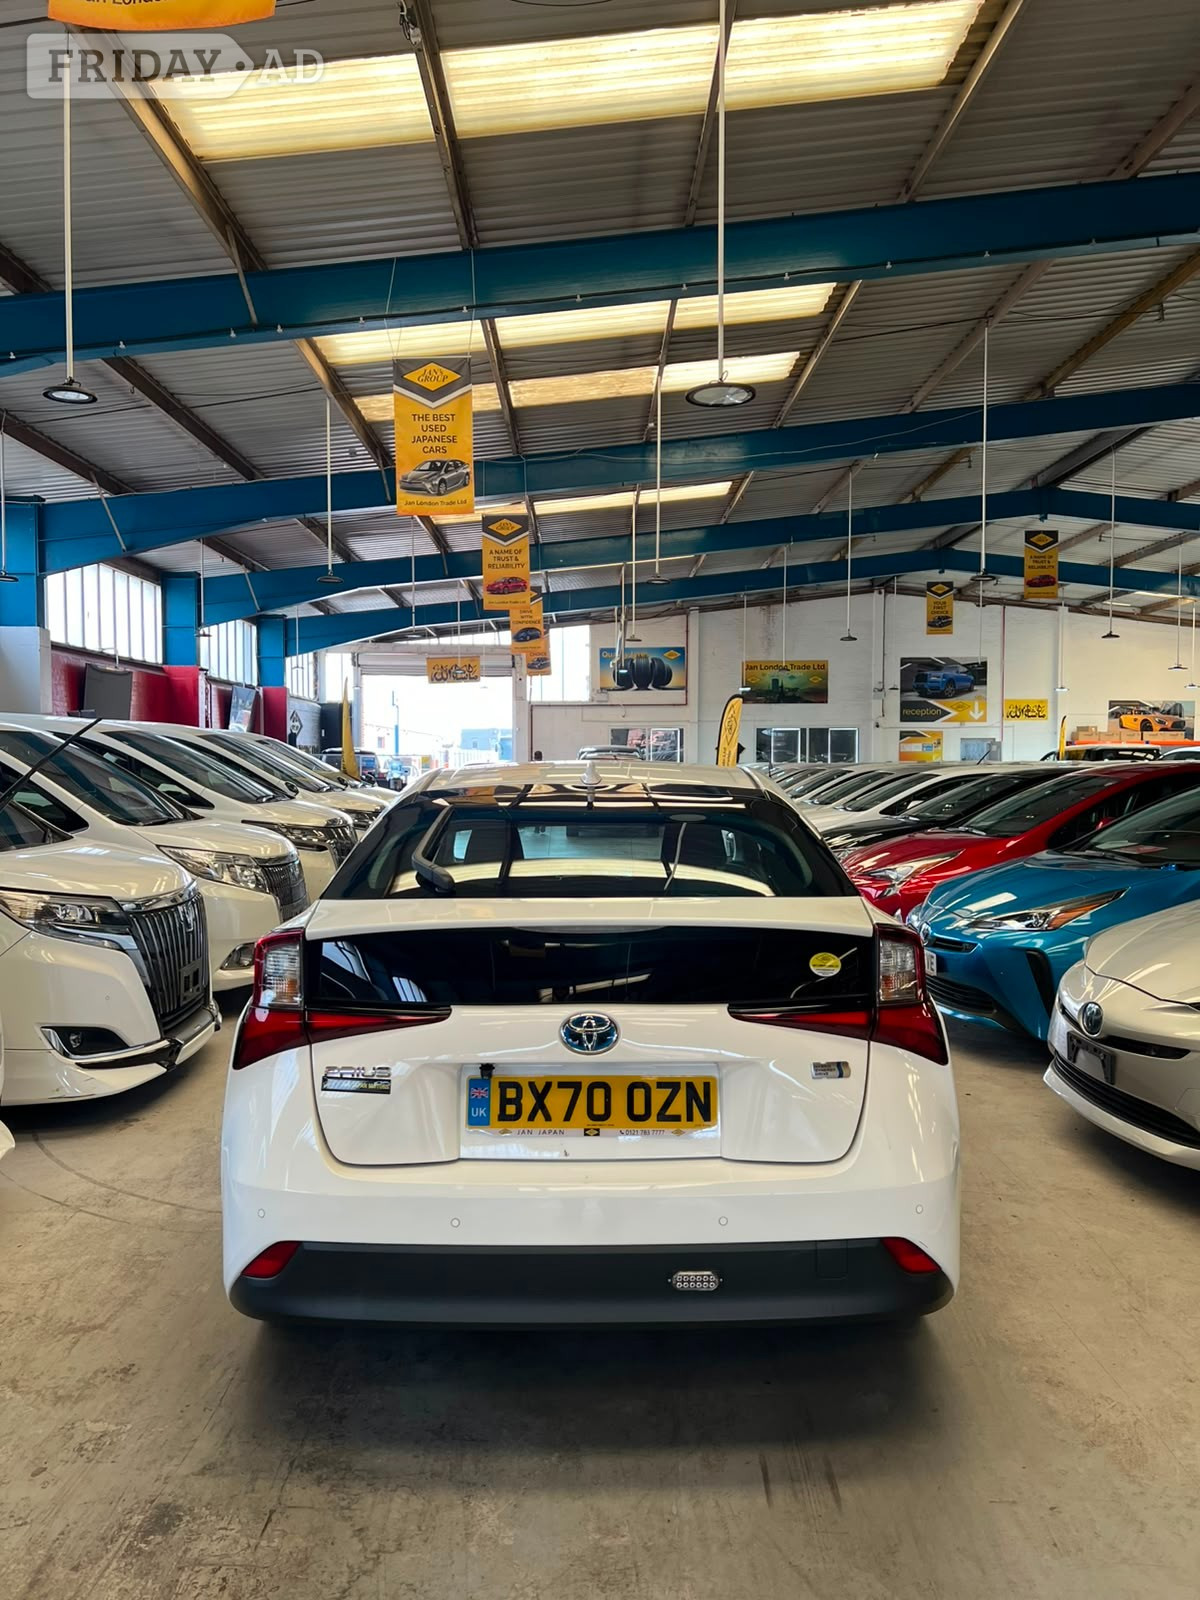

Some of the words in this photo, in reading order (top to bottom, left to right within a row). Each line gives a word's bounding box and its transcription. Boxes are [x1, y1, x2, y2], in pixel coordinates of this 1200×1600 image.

[417, 375, 448, 383] GROUP
[412, 413, 430, 422] THE
[432, 413, 456, 422] BEST
[421, 424, 447, 433] USED
[411, 435, 458, 444] JAPANESE
[422, 445, 447, 454] CARS
[745, 663, 758, 671] Jan
[759, 663, 788, 671] London
[902, 707, 942, 717] reception
[497, 1081, 612, 1122] BX70
[627, 1081, 711, 1122] OZN
[471, 1107, 487, 1118] UK
